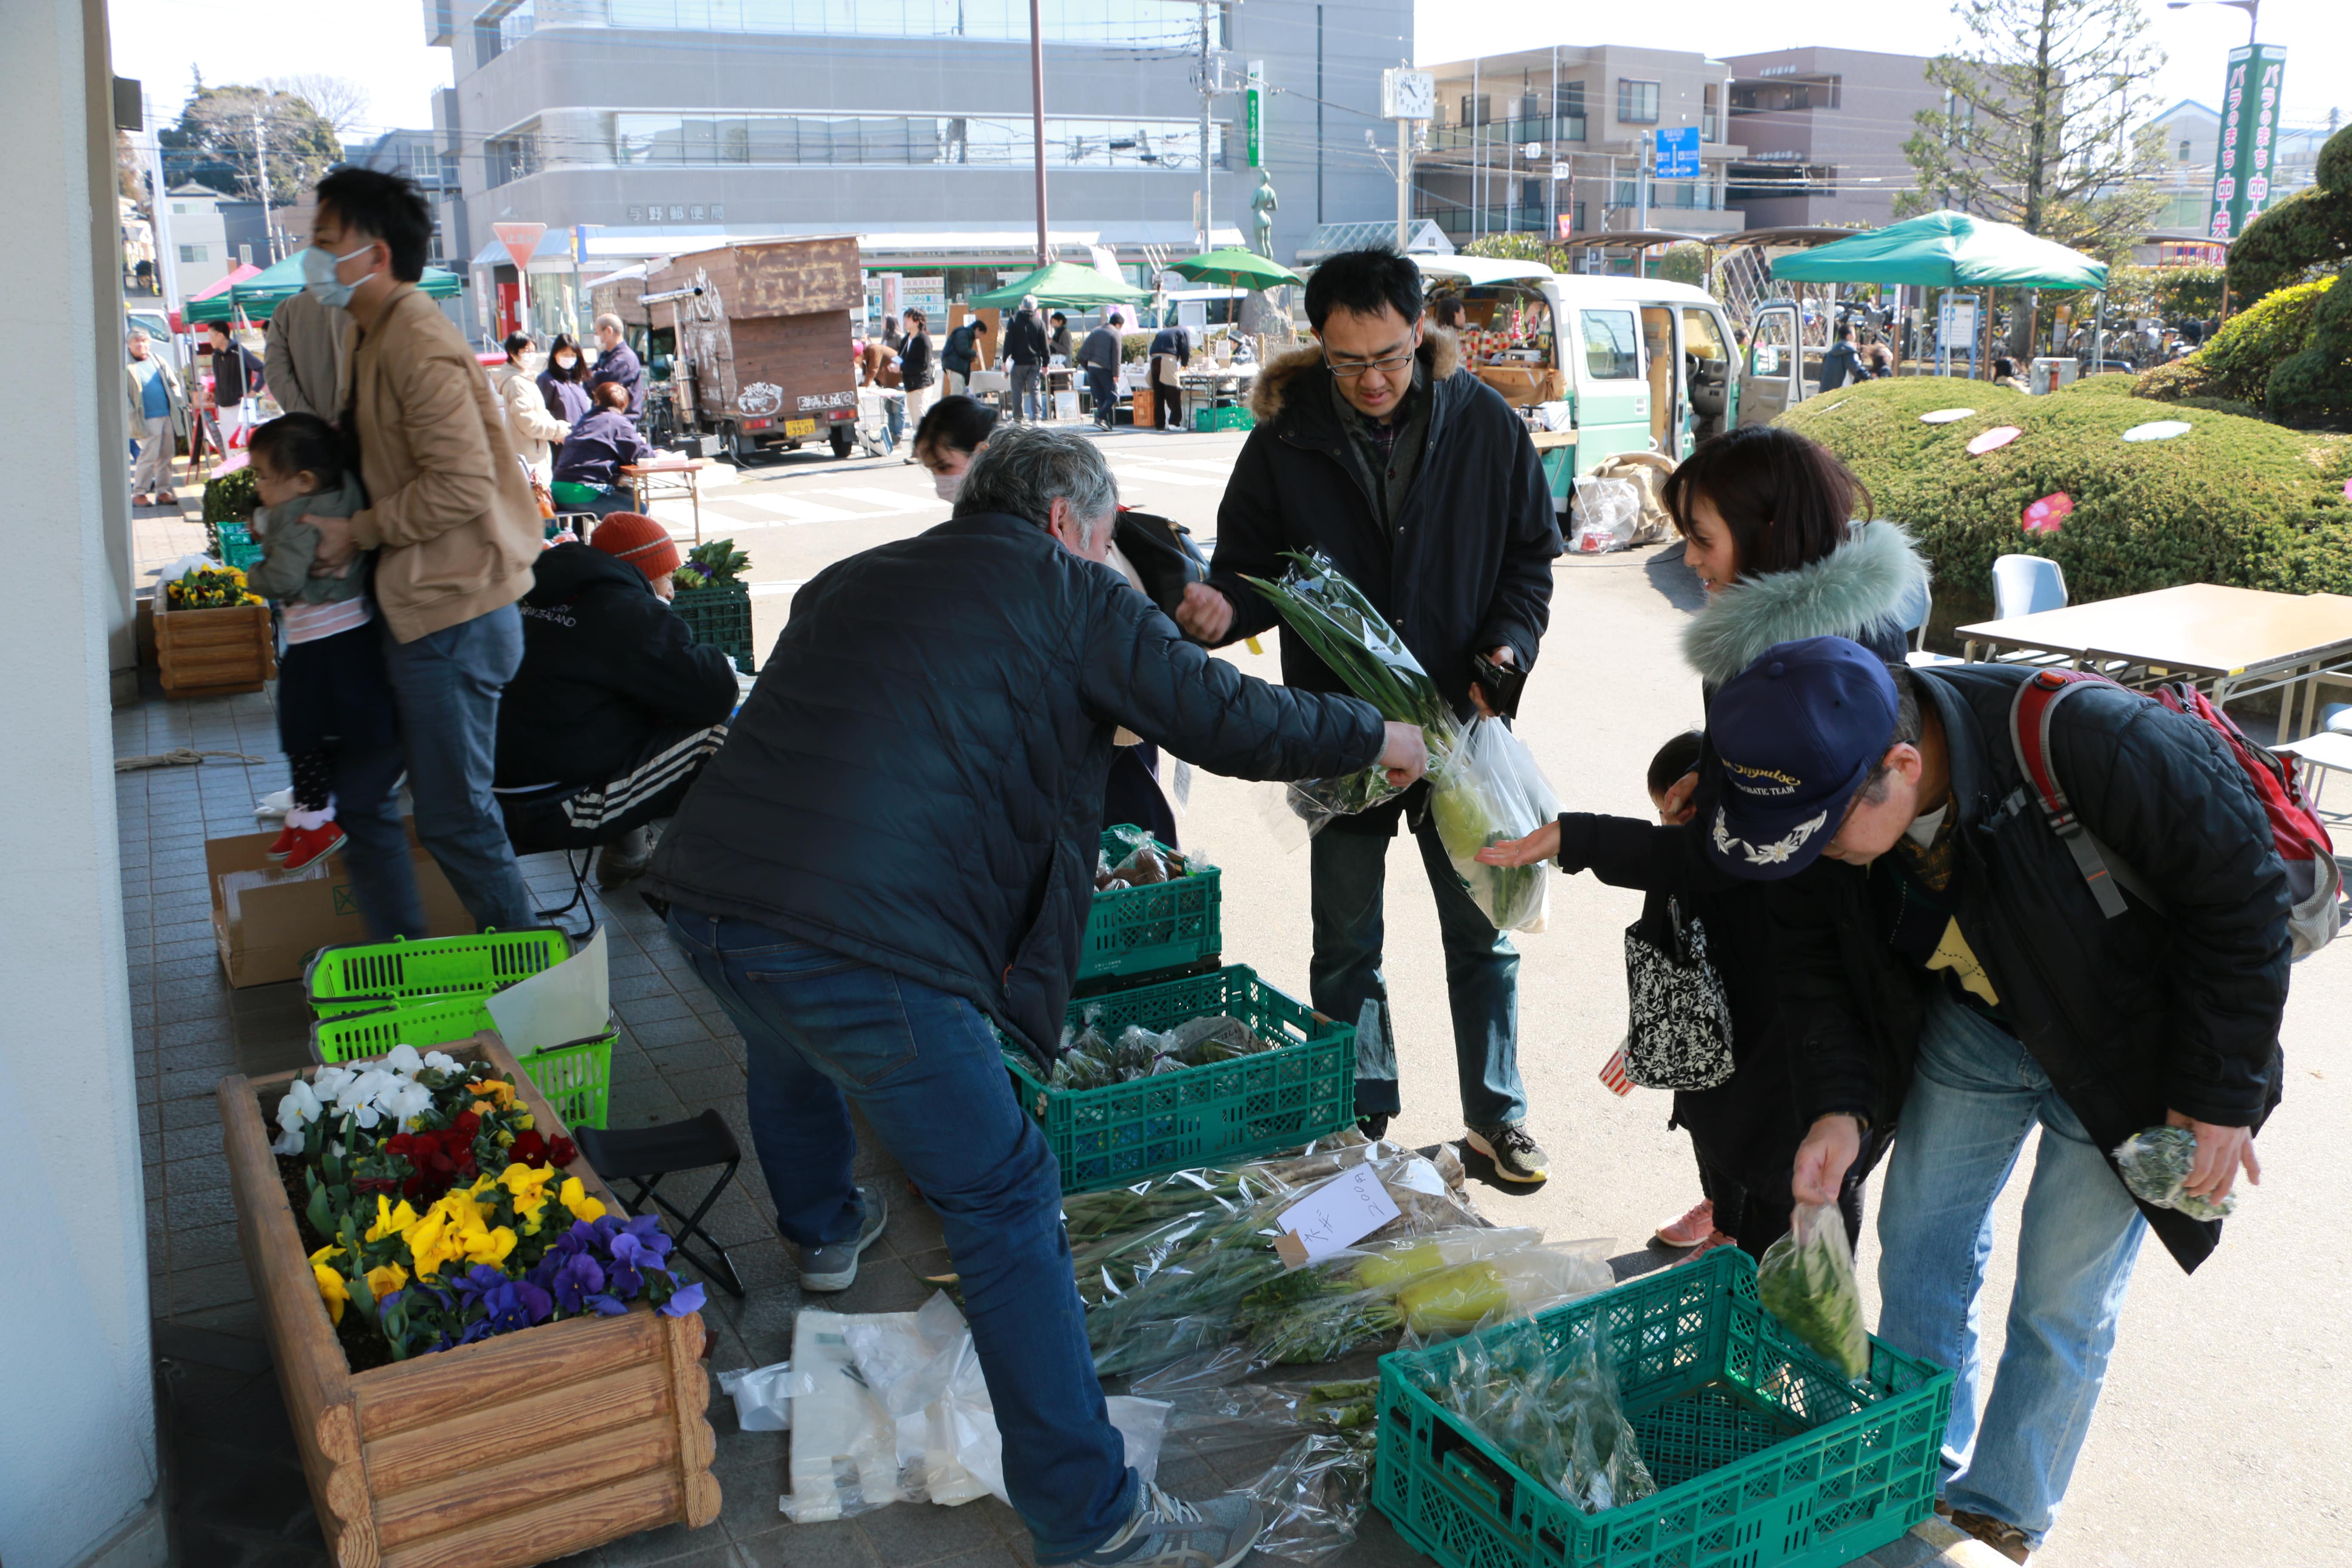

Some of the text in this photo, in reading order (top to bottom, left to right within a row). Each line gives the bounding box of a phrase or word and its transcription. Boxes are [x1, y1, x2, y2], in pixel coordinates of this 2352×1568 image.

[628, 205, 725, 221] 与野郵便局
[519, 606, 537, 616] NEW
[536, 609, 577, 627] ZEALAND
[1770, 785, 1795, 796] TEAM
